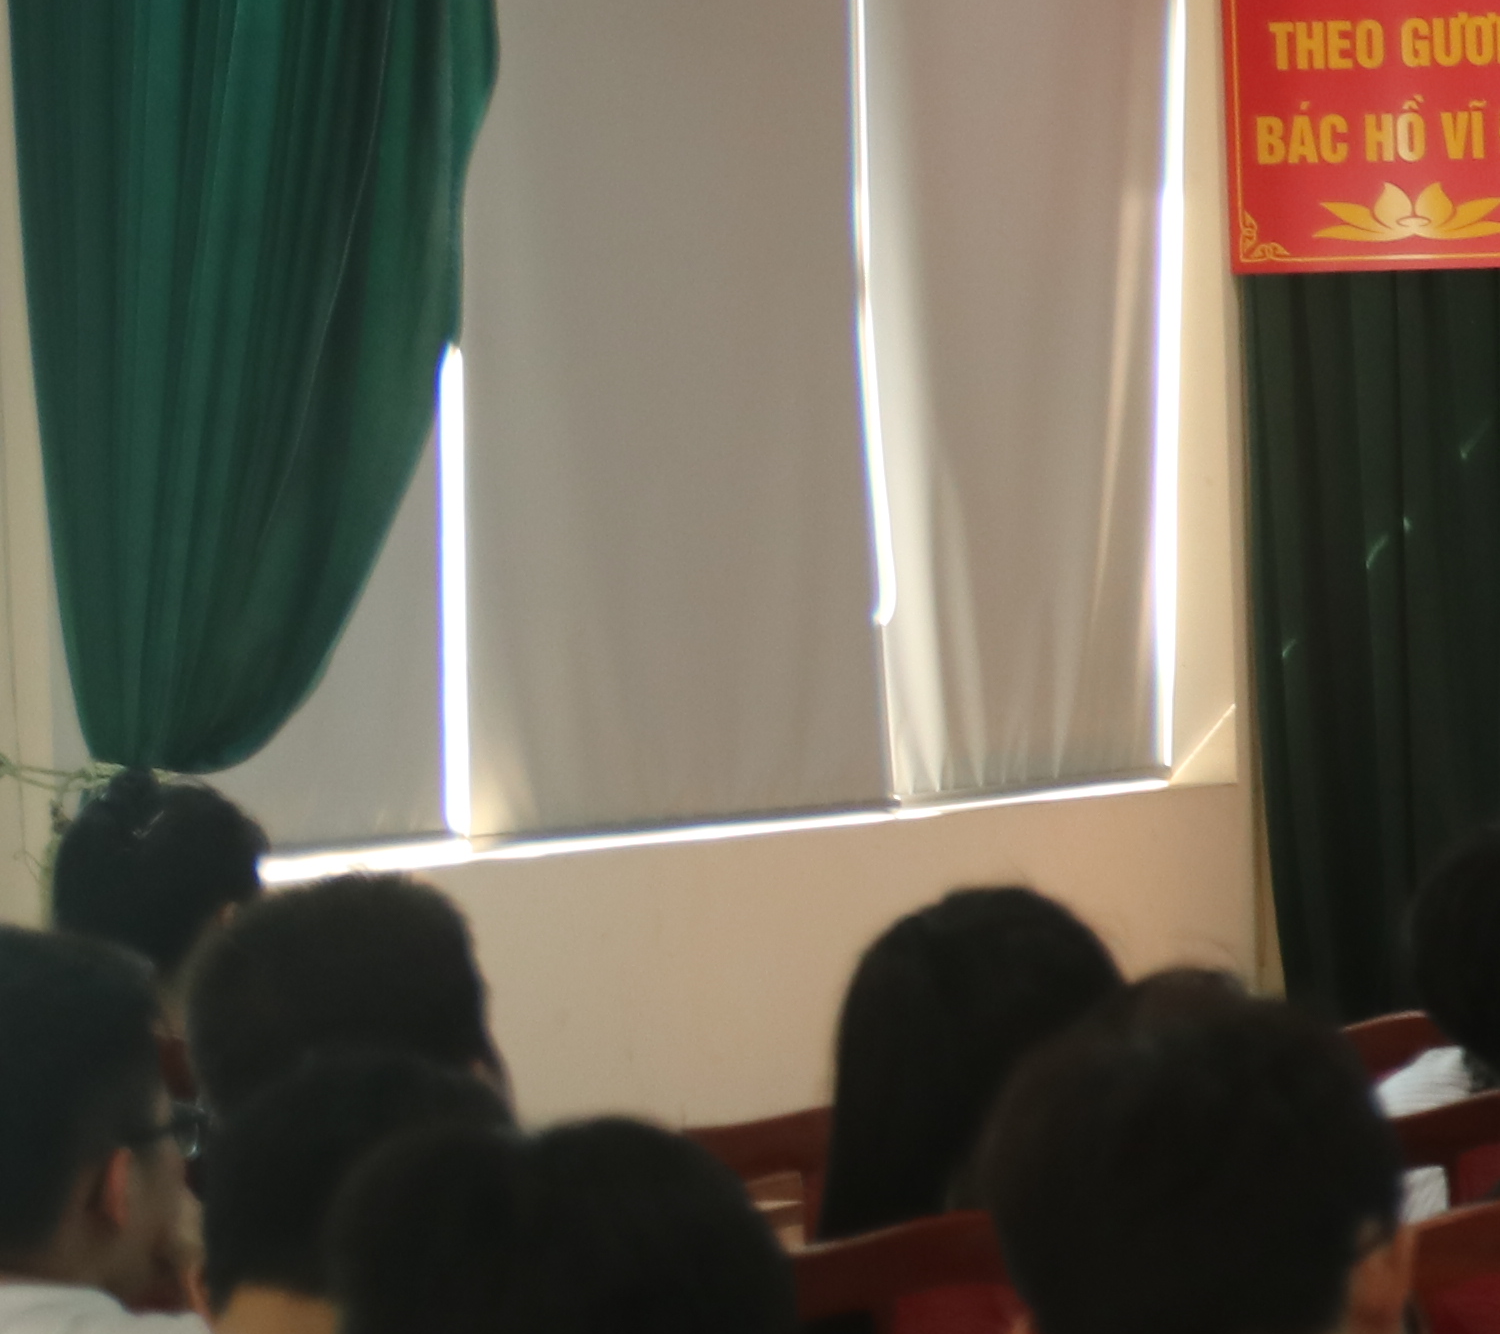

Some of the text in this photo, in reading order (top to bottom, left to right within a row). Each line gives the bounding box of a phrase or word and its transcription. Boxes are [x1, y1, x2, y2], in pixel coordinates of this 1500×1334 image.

[1270, 19, 1385, 69] THEO
[1257, 102, 1349, 164] BÁC
[1366, 95, 1425, 162] HỒ
[1441, 101, 1484, 159] VĨ
